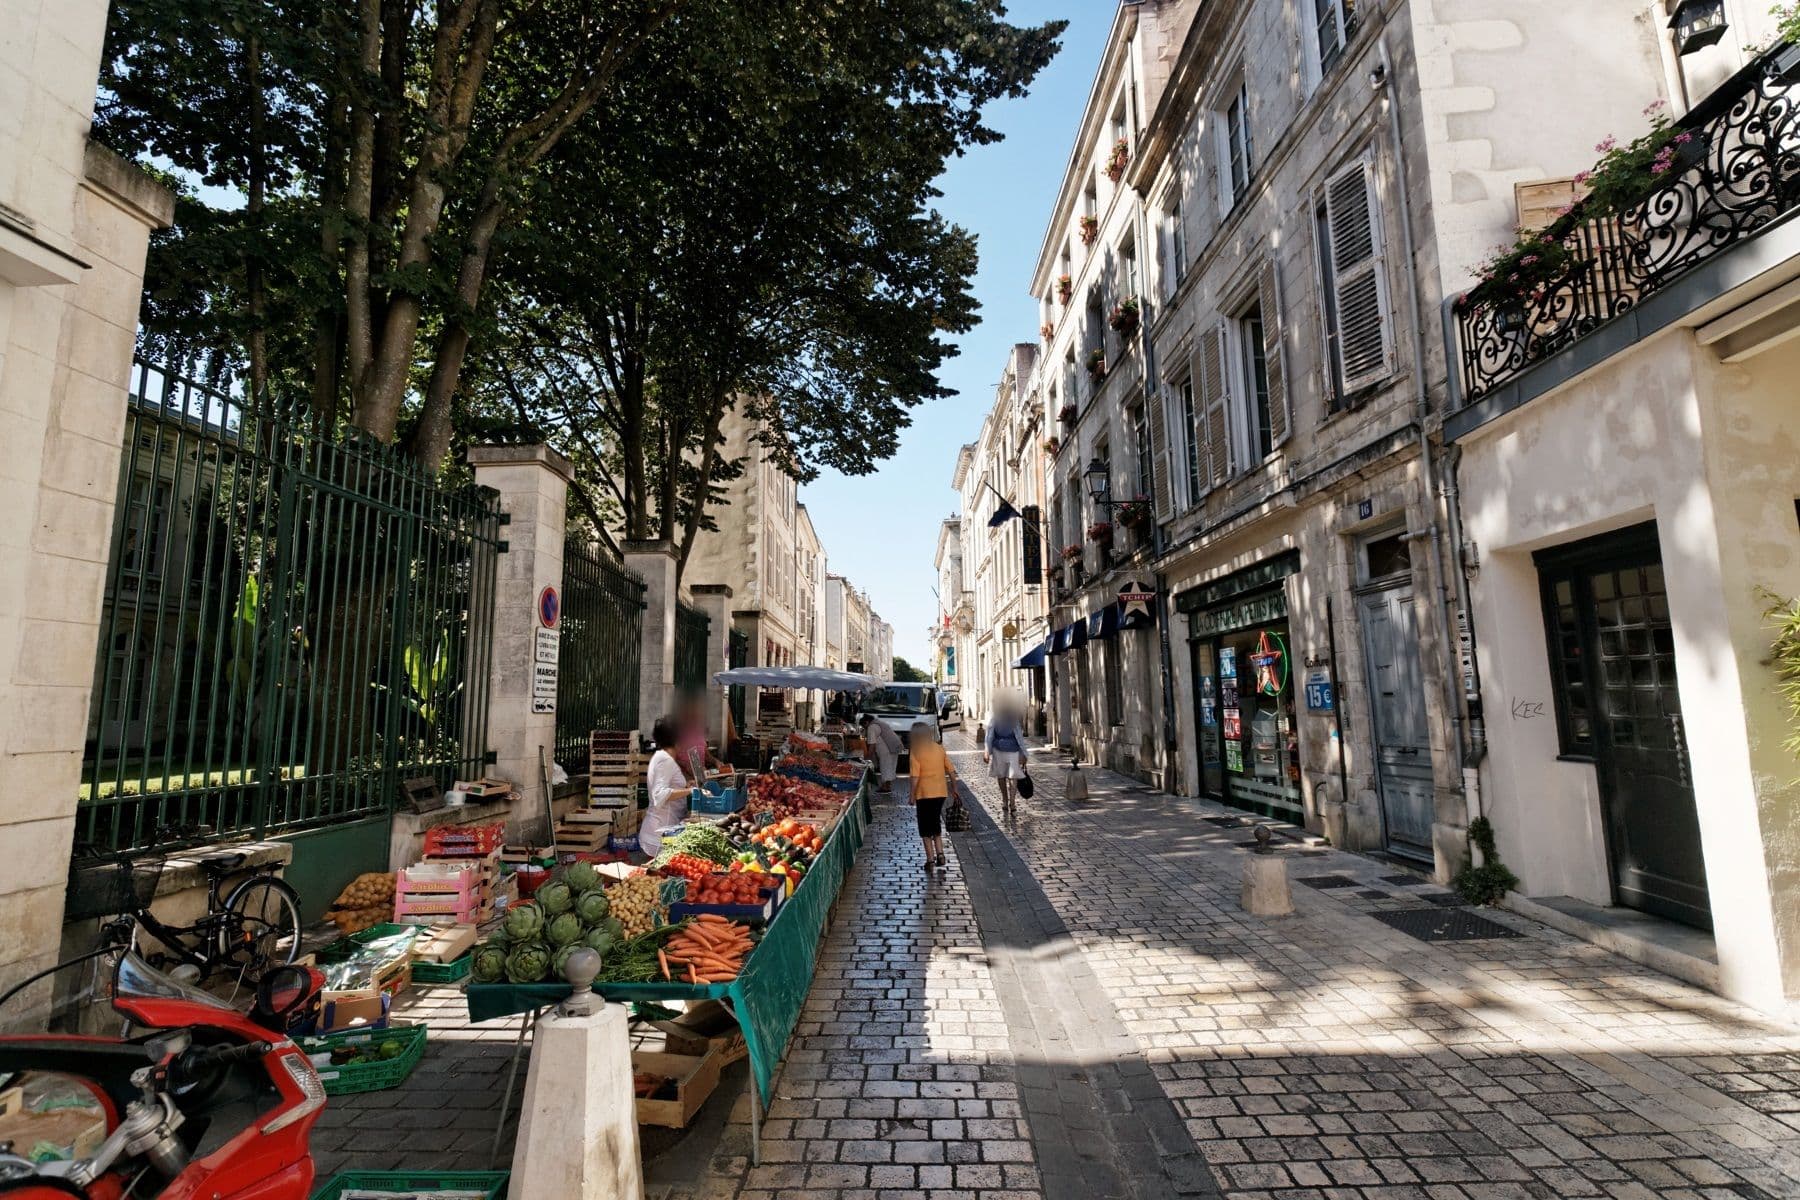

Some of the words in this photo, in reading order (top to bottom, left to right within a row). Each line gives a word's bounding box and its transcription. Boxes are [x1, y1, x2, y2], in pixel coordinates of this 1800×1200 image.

[1360, 504, 1370, 517] 16
[1304, 655, 1329, 668] Coiffure
[1307, 685, 1322, 707] 15
